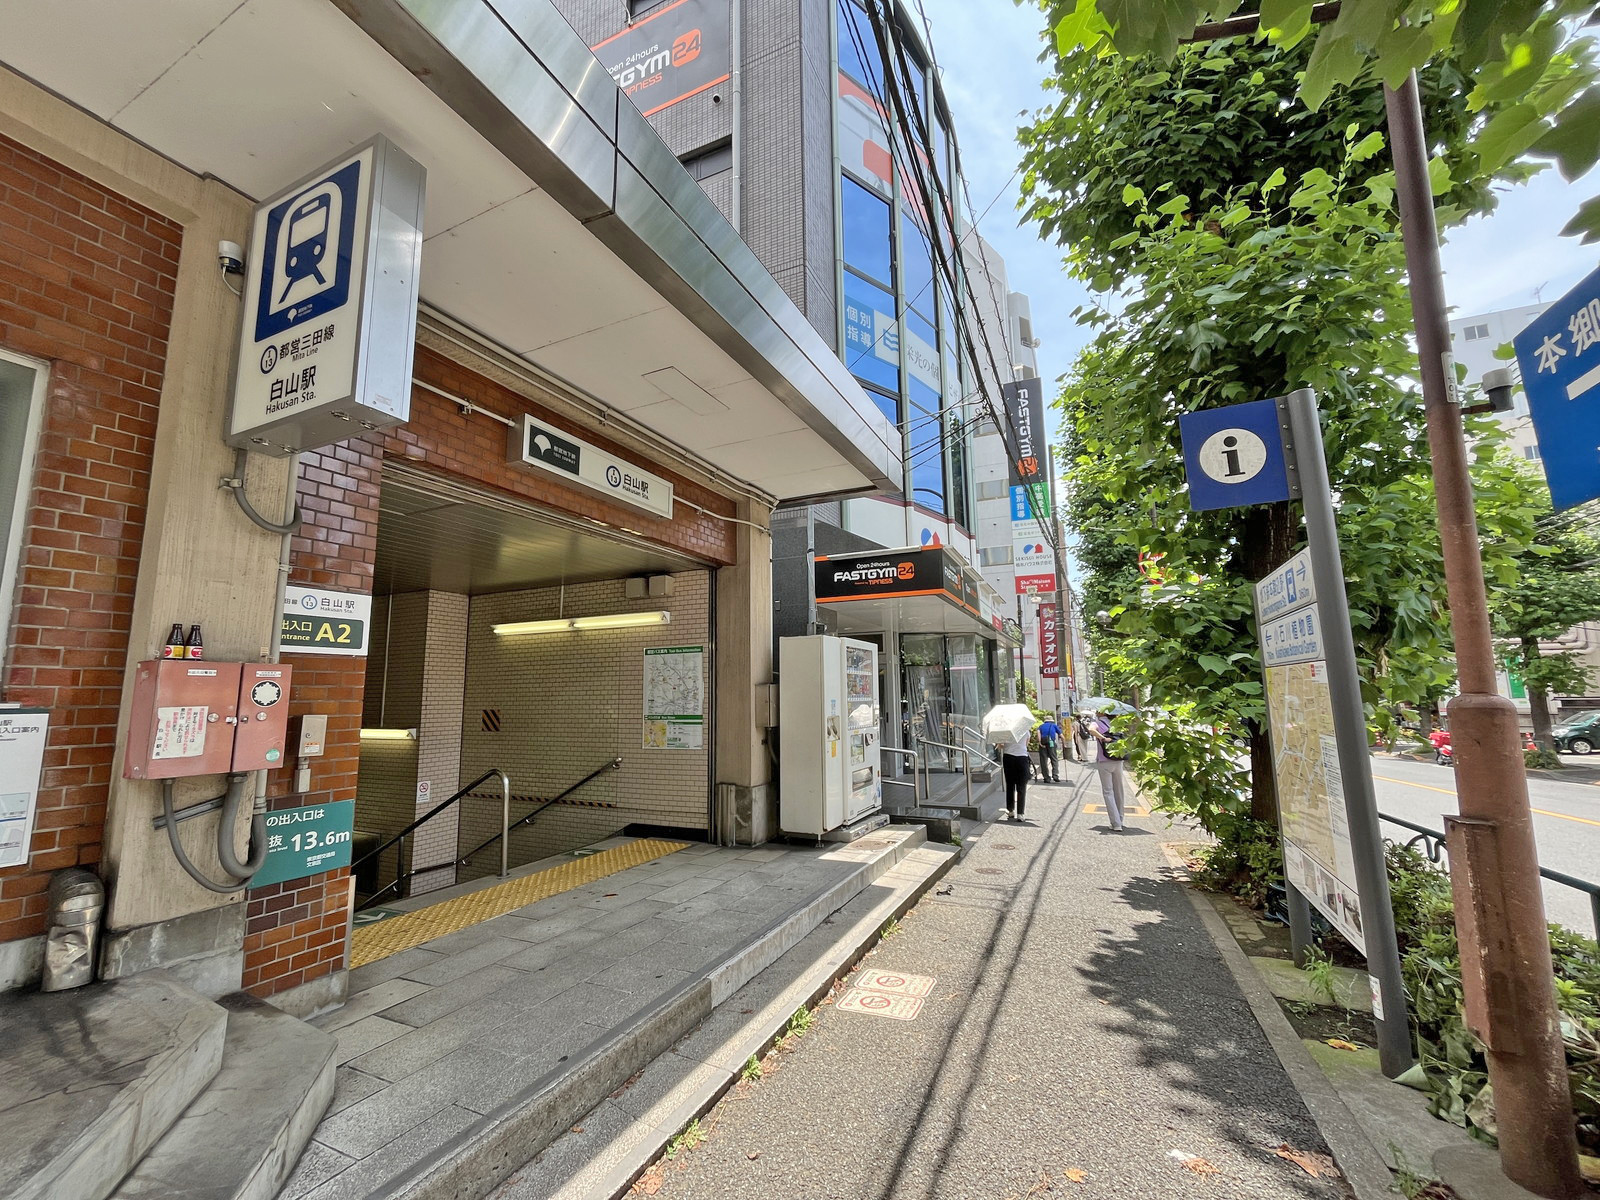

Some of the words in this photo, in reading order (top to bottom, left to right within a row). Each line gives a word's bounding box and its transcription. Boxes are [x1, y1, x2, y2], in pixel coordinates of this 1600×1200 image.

[673, 33, 702, 61] 24
[606, 61, 624, 74] pen
[625, 44, 659, 66] 24hours
[846, 305, 871, 329] 個別
[280, 324, 335, 360] 都営三田線
[847, 325, 872, 348] 指導
[265, 358, 273, 368] 13
[292, 352, 305, 362] Mita
[306, 347, 319, 357] Line
[270, 365, 317, 402] 白山駅
[265, 396, 299, 415] Hakusan
[301, 391, 317, 403] Sta.
[1018, 389, 1033, 458] FASTGYM
[610, 475, 618, 484] 13
[623, 473, 649, 494] 白山駅
[622, 485, 641, 497] Hakusan
[834, 566, 898, 582] FASTGYM
[898, 566, 915, 576] 24
[868, 578, 893, 586] TIPNESS
[321, 597, 355, 609] 白山駅
[281, 619, 312, 632] 出入口
[315, 622, 351, 643] A2
[1044, 620, 1057, 666] カラオケ
[266, 808, 325, 827] の出入口は
[268, 834, 283, 848] 抜
[291, 830, 350, 852] 13.6m
